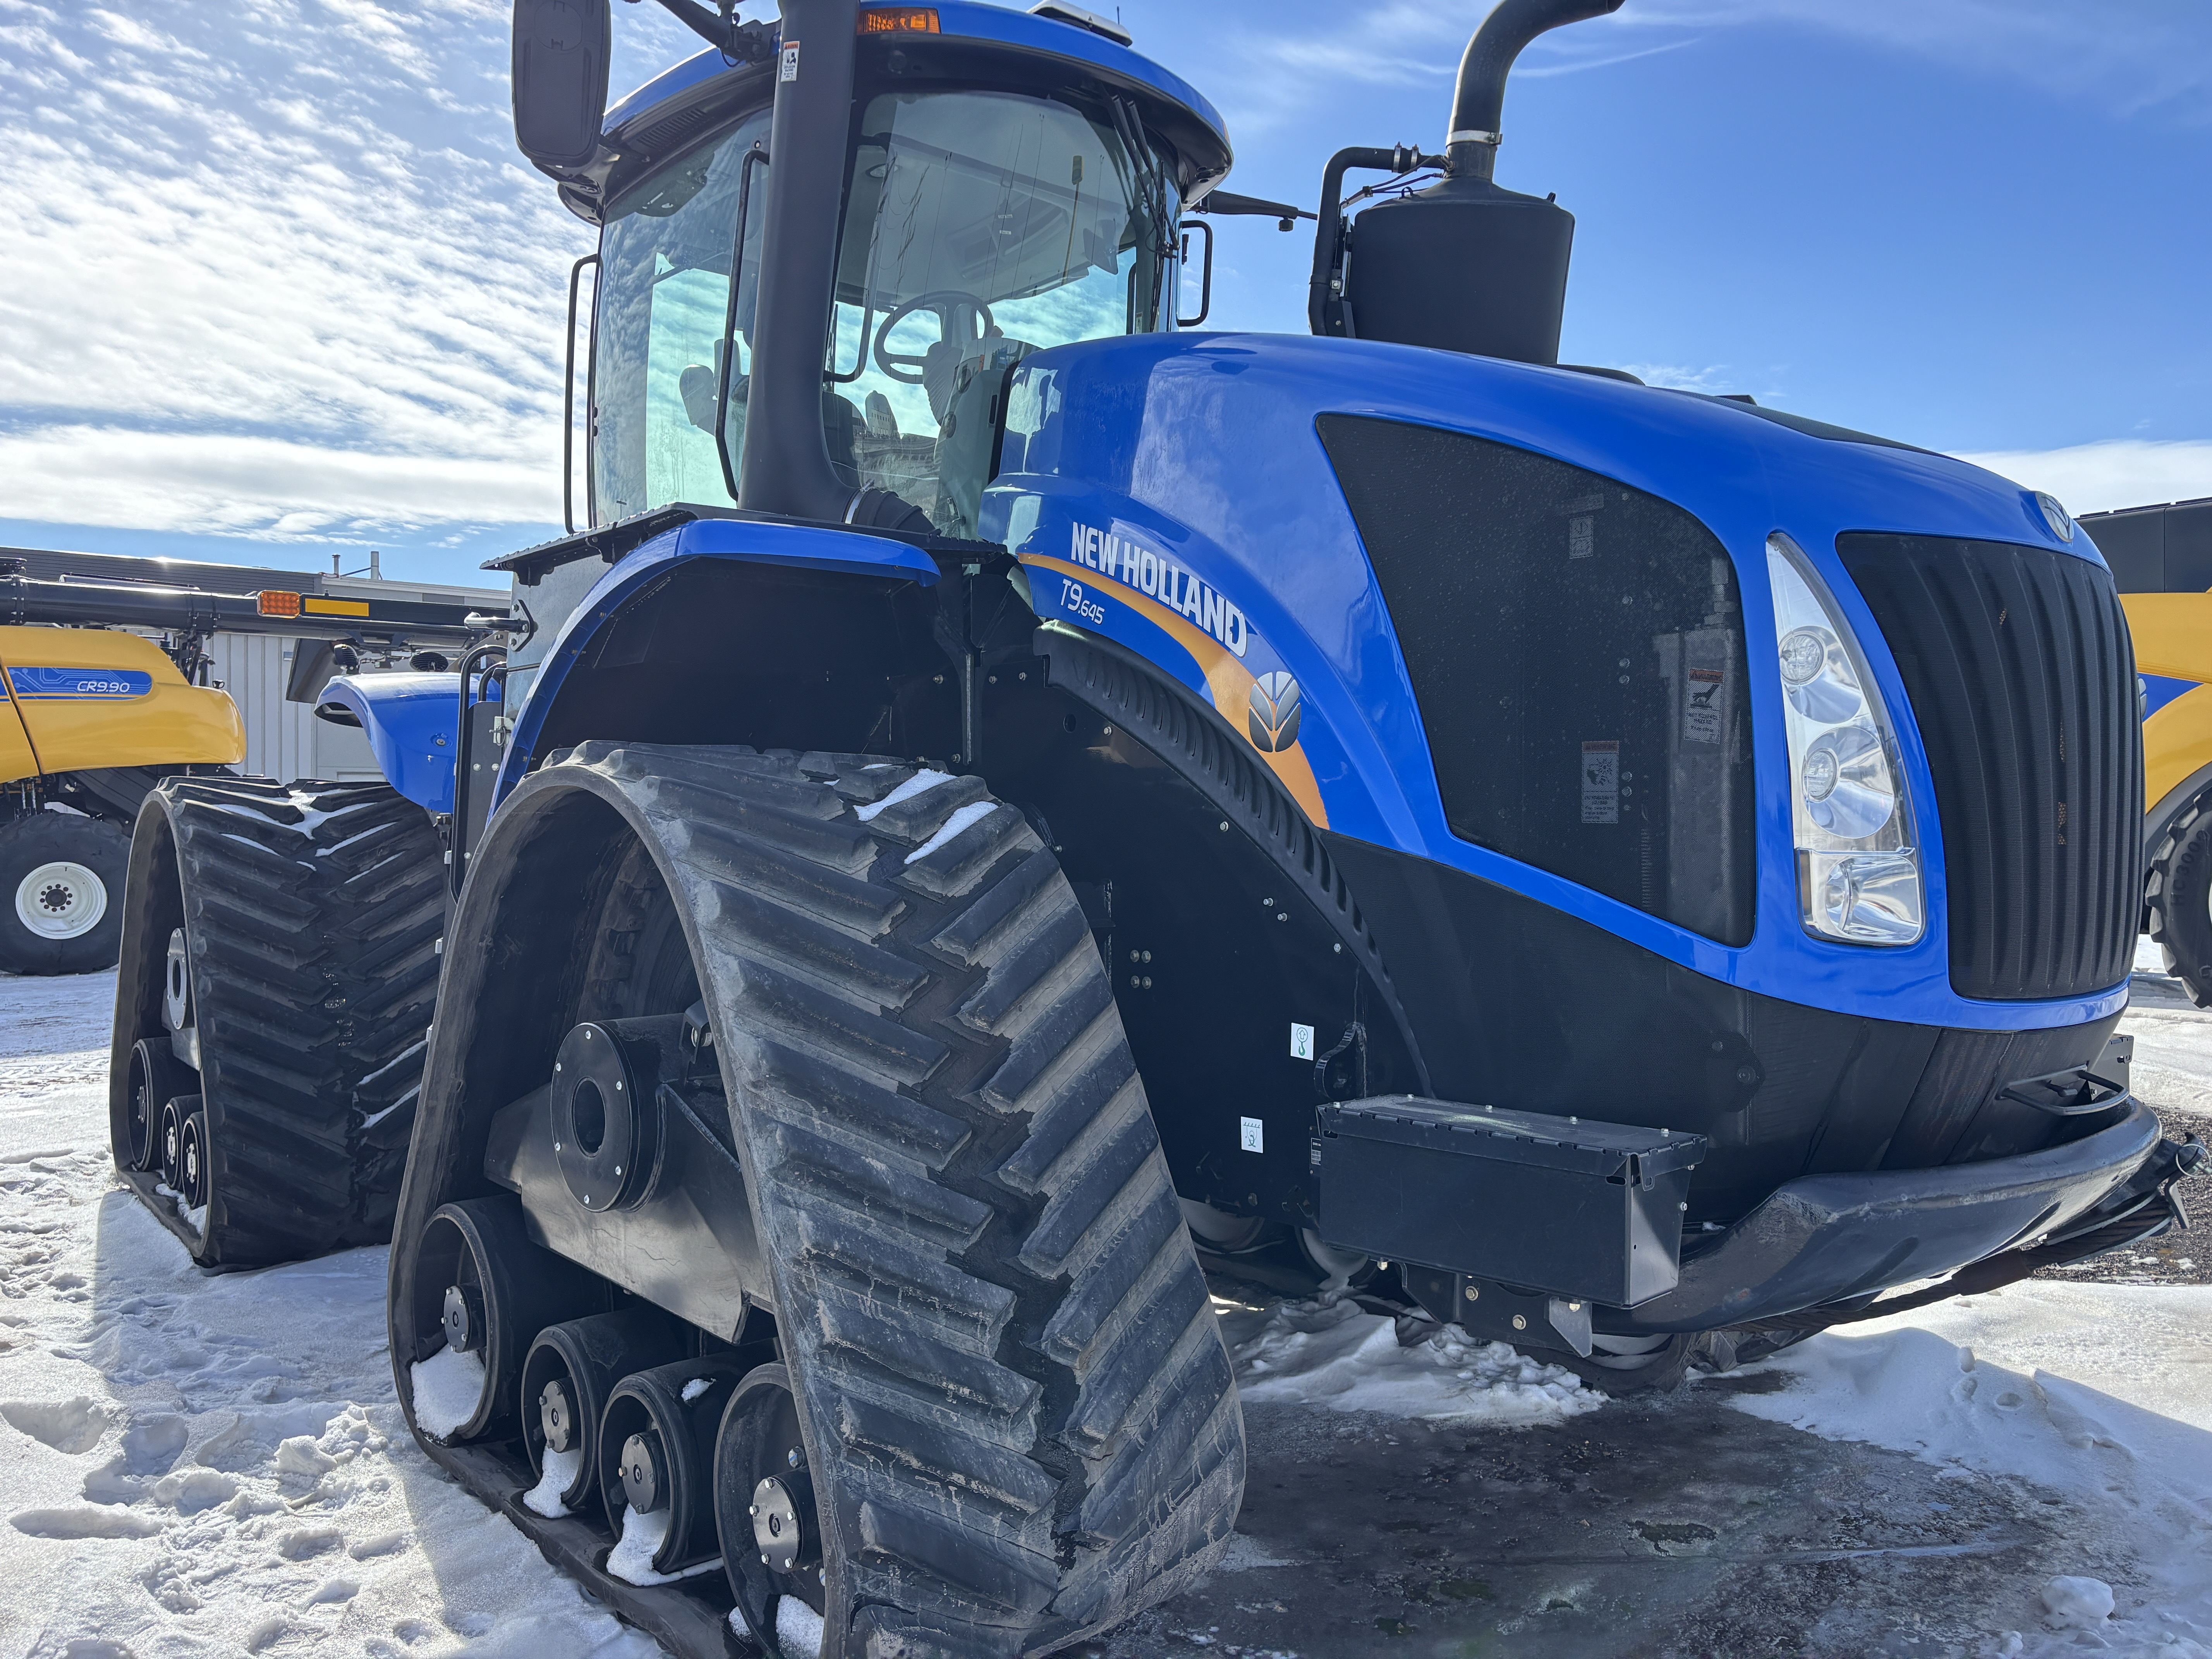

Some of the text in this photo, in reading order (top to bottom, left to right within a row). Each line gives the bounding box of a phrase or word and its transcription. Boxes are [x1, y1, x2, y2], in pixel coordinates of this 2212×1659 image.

[1060, 579, 1105, 625] T9.645
[1071, 522, 1247, 657] NEW HOLLAND
[77, 681, 130, 693] CR9.90
